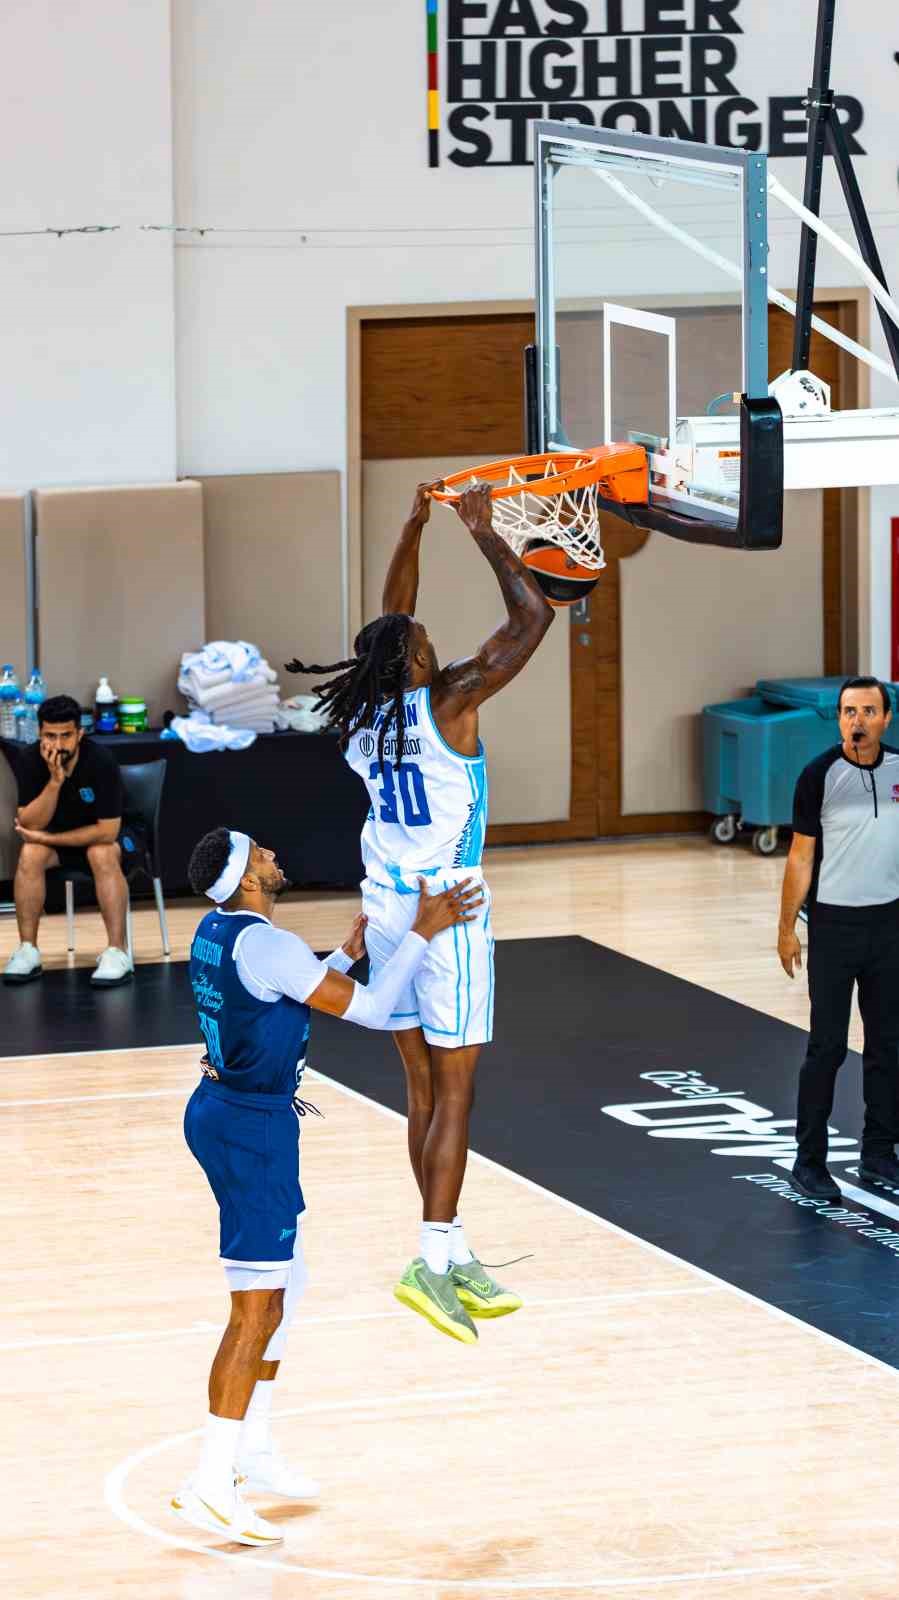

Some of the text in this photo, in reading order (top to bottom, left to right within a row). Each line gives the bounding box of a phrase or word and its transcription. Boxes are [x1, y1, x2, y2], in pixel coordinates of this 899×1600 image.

[447, 0, 743, 38] FASTER
[447, 35, 741, 101] HIGHER
[368, 761, 432, 827] 30
[639, 1070, 746, 1099] özel
